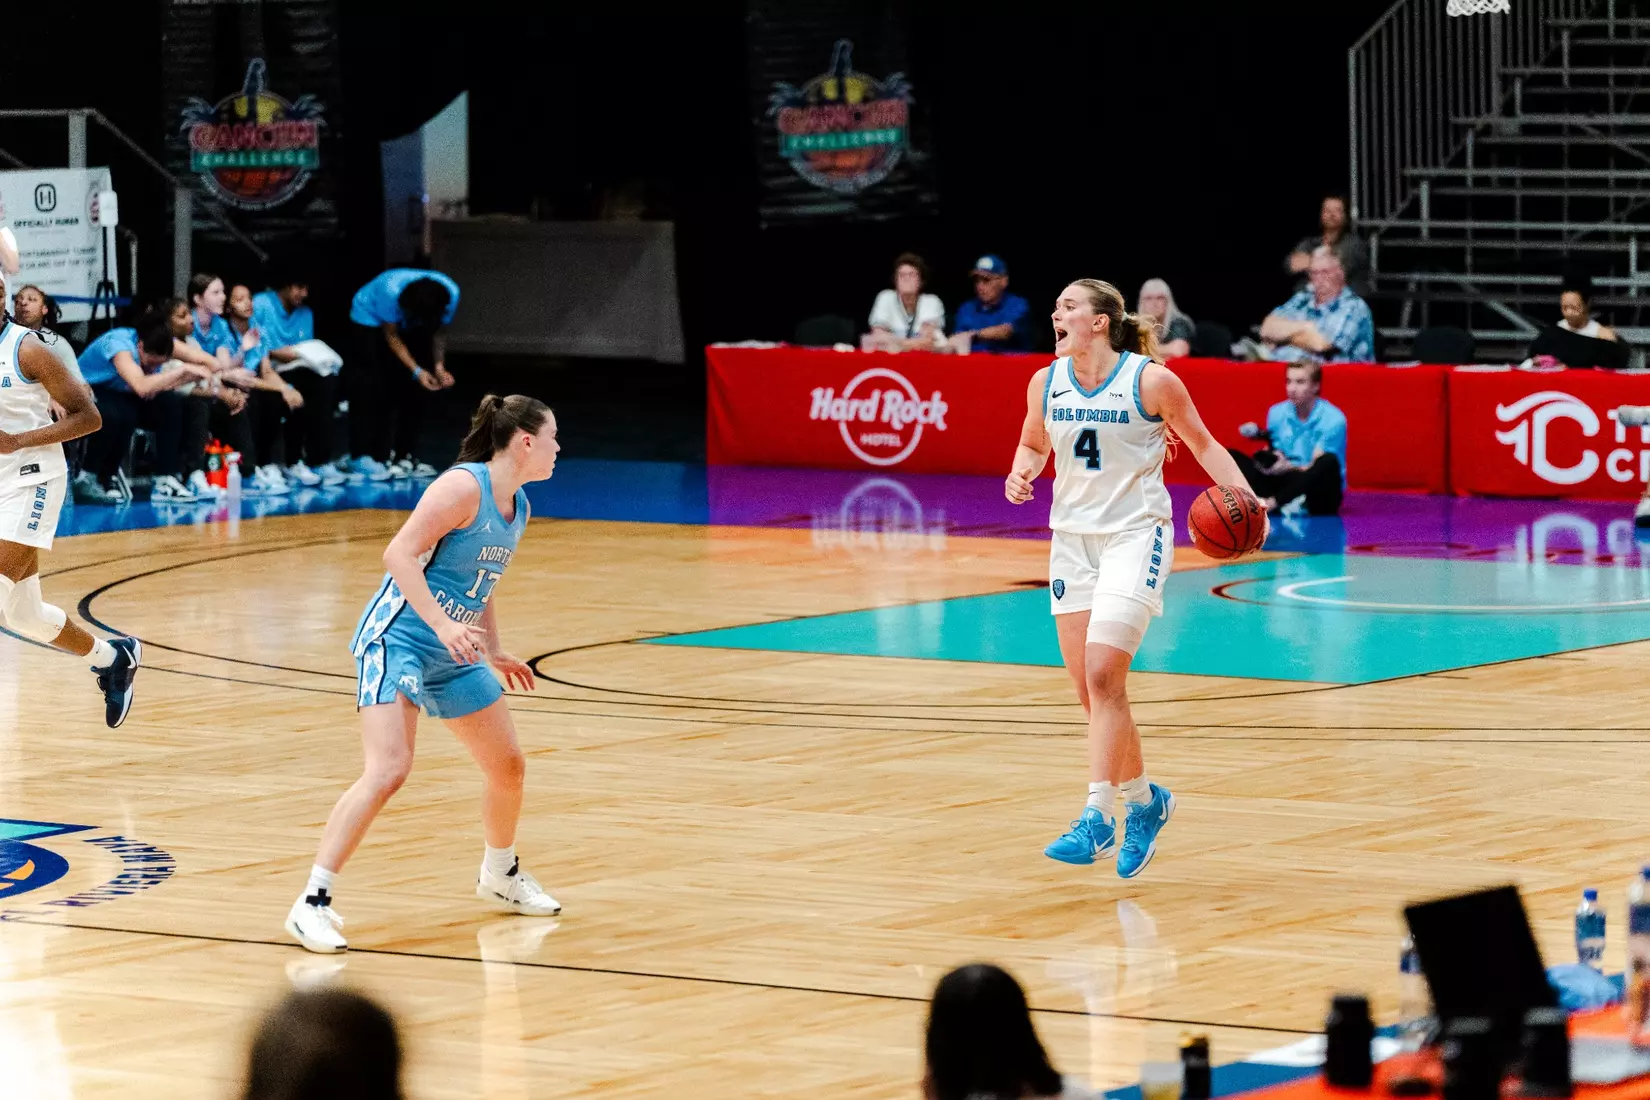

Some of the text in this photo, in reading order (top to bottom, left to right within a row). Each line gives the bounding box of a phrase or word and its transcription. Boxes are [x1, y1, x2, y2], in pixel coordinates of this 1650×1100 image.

[809, 387, 949, 431] Hard Rock
[1052, 408, 1130, 424] COLUMBIA
[860, 432, 903, 447] HOTEL
[1073, 428, 1101, 471] 4
[1146, 525, 1163, 589] LIONS
[465, 568, 503, 603] 17
